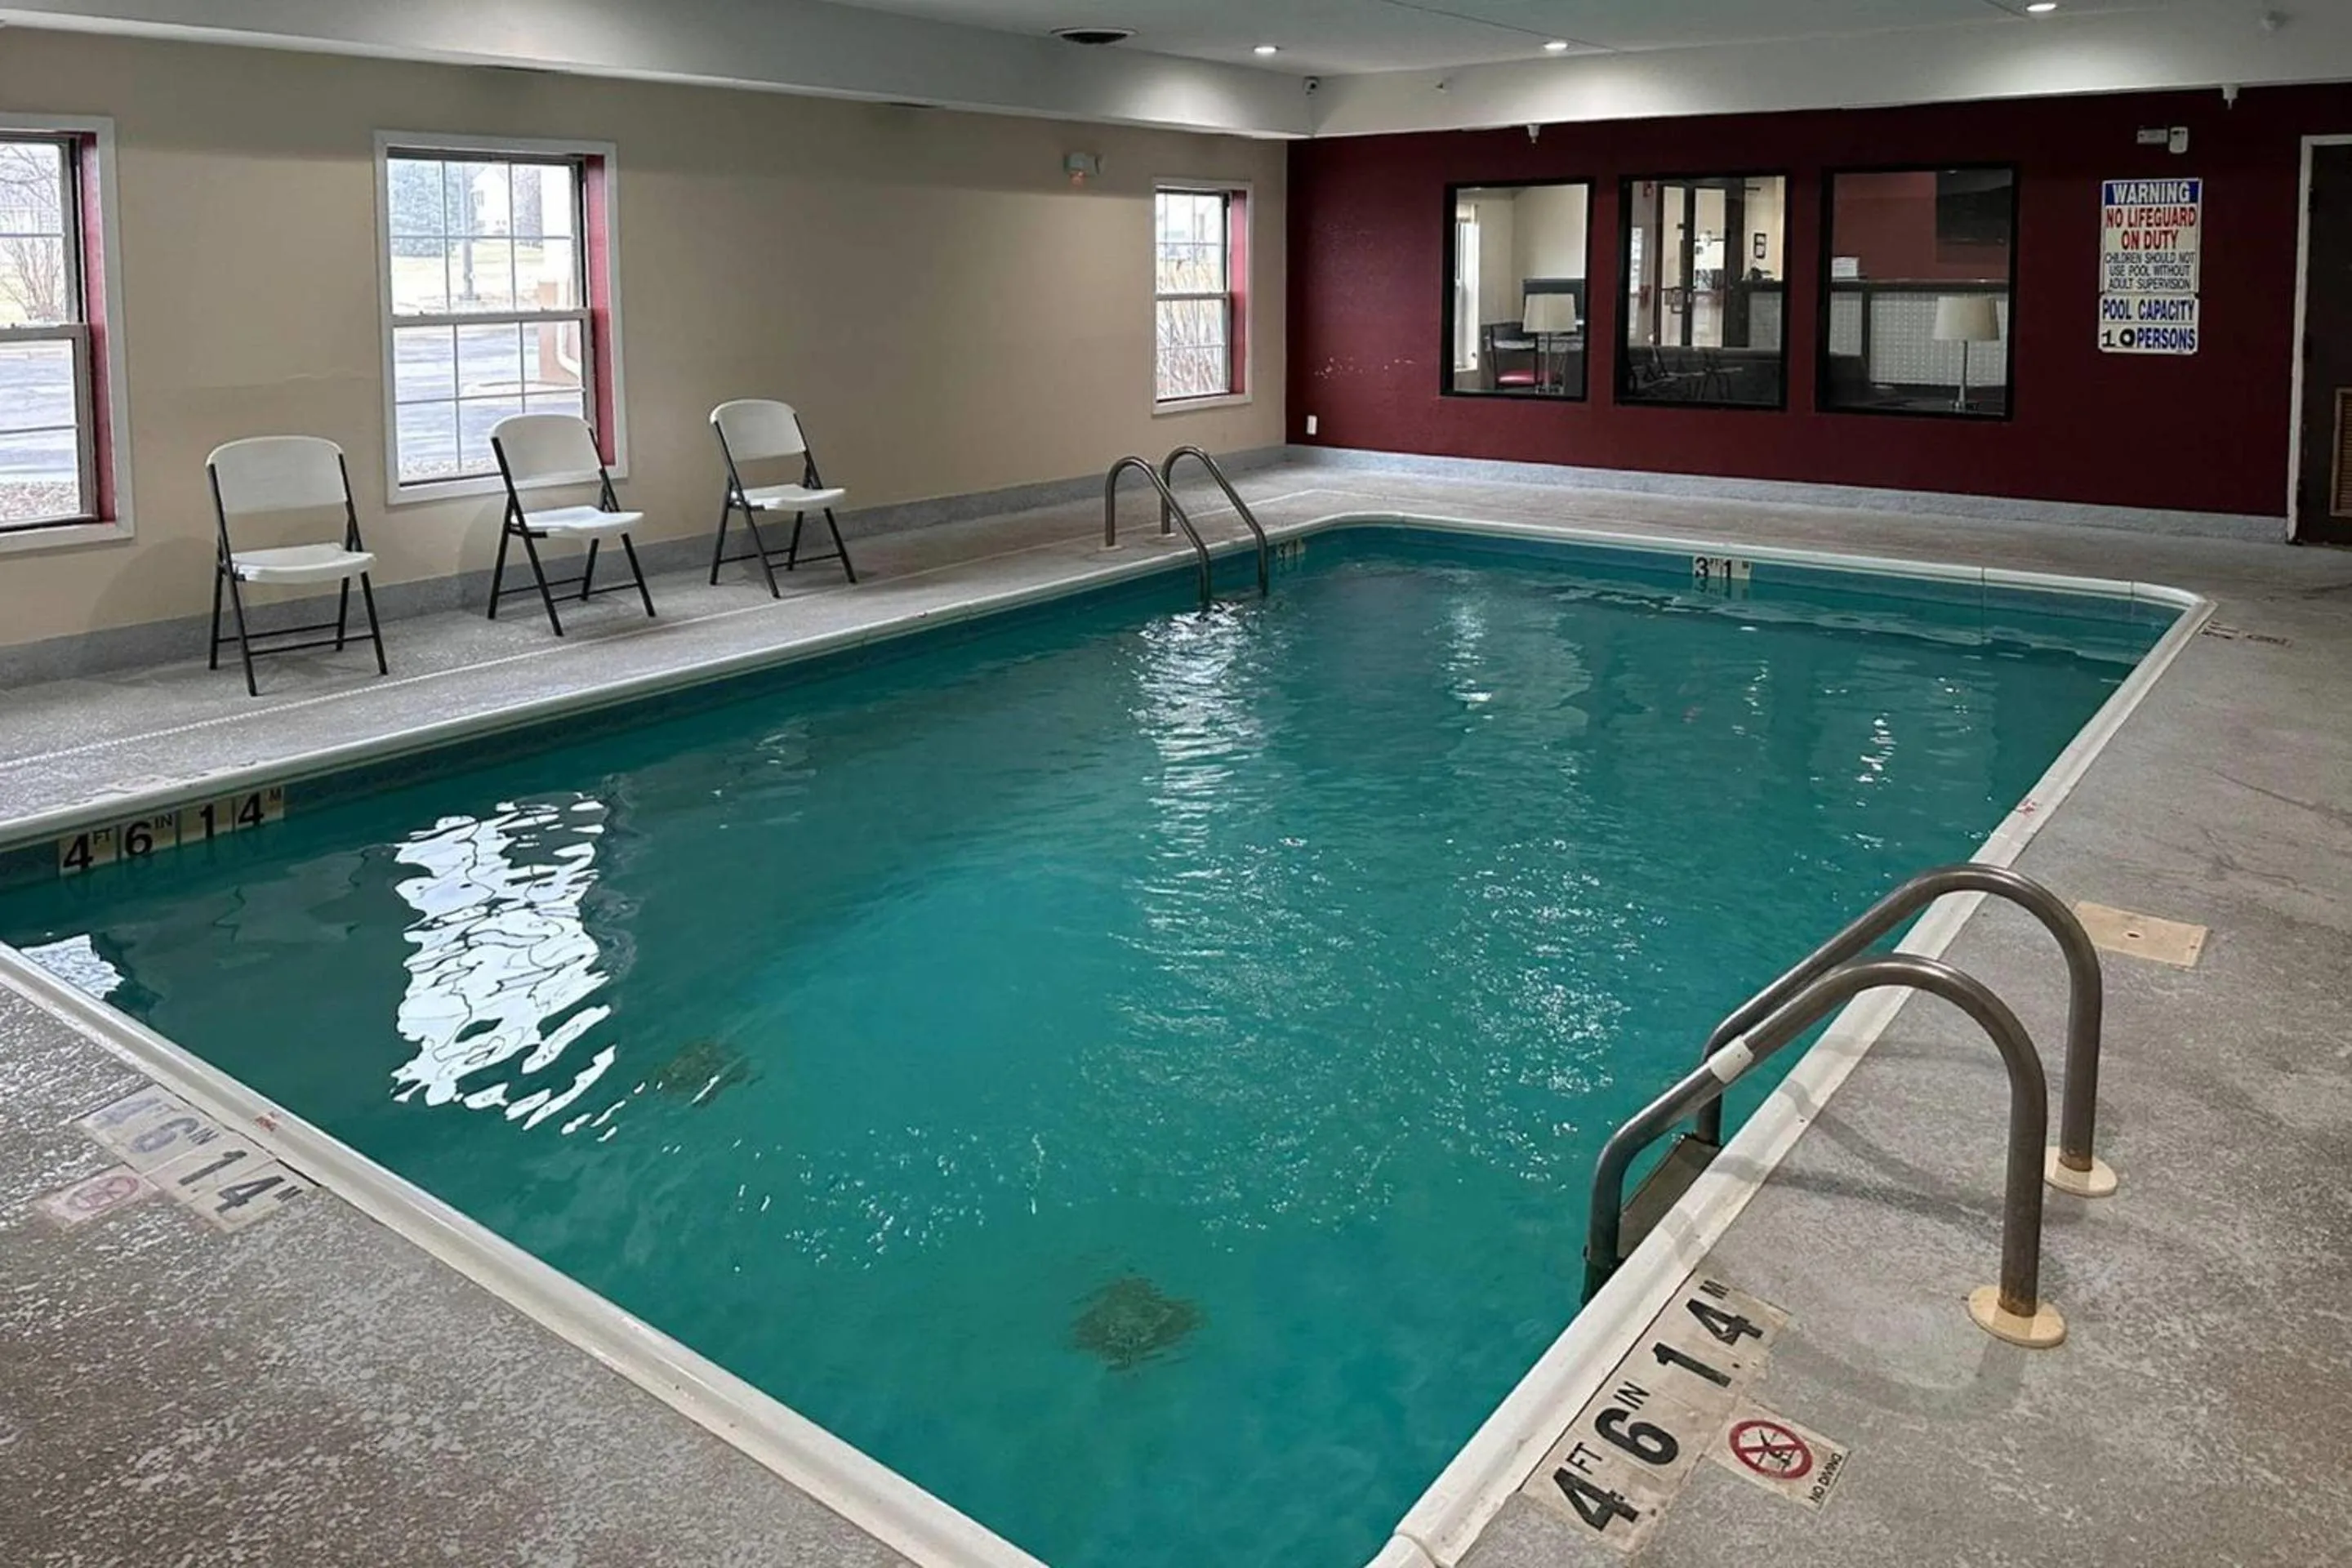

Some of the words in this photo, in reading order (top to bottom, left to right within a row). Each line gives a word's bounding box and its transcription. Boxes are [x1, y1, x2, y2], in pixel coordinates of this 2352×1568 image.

[2113, 182, 2189, 203] WARNING
[2106, 208, 2123, 228] NO
[2127, 207, 2197, 227] LIFEGUARD
[2122, 230, 2140, 249] ON
[2144, 229, 2179, 249] DUTY
[2145, 252, 2176, 264] SHOULD
[2178, 252, 2195, 264] NOT
[2109, 265, 2125, 276] USE
[2128, 265, 2149, 276] POOL
[2153, 265, 2190, 276] WITHOUT
[2109, 278, 2131, 289] ADULT
[2137, 278, 2190, 289] SUPERVISION
[2103, 299, 2132, 319] POOL
[2138, 299, 2195, 320] CAPACITY
[2102, 328, 2136, 347] 10
[2137, 327, 2195, 350] PERSONS
[1808, 1486, 1824, 1503] NO
[1818, 1453, 1842, 1486] DIVING
